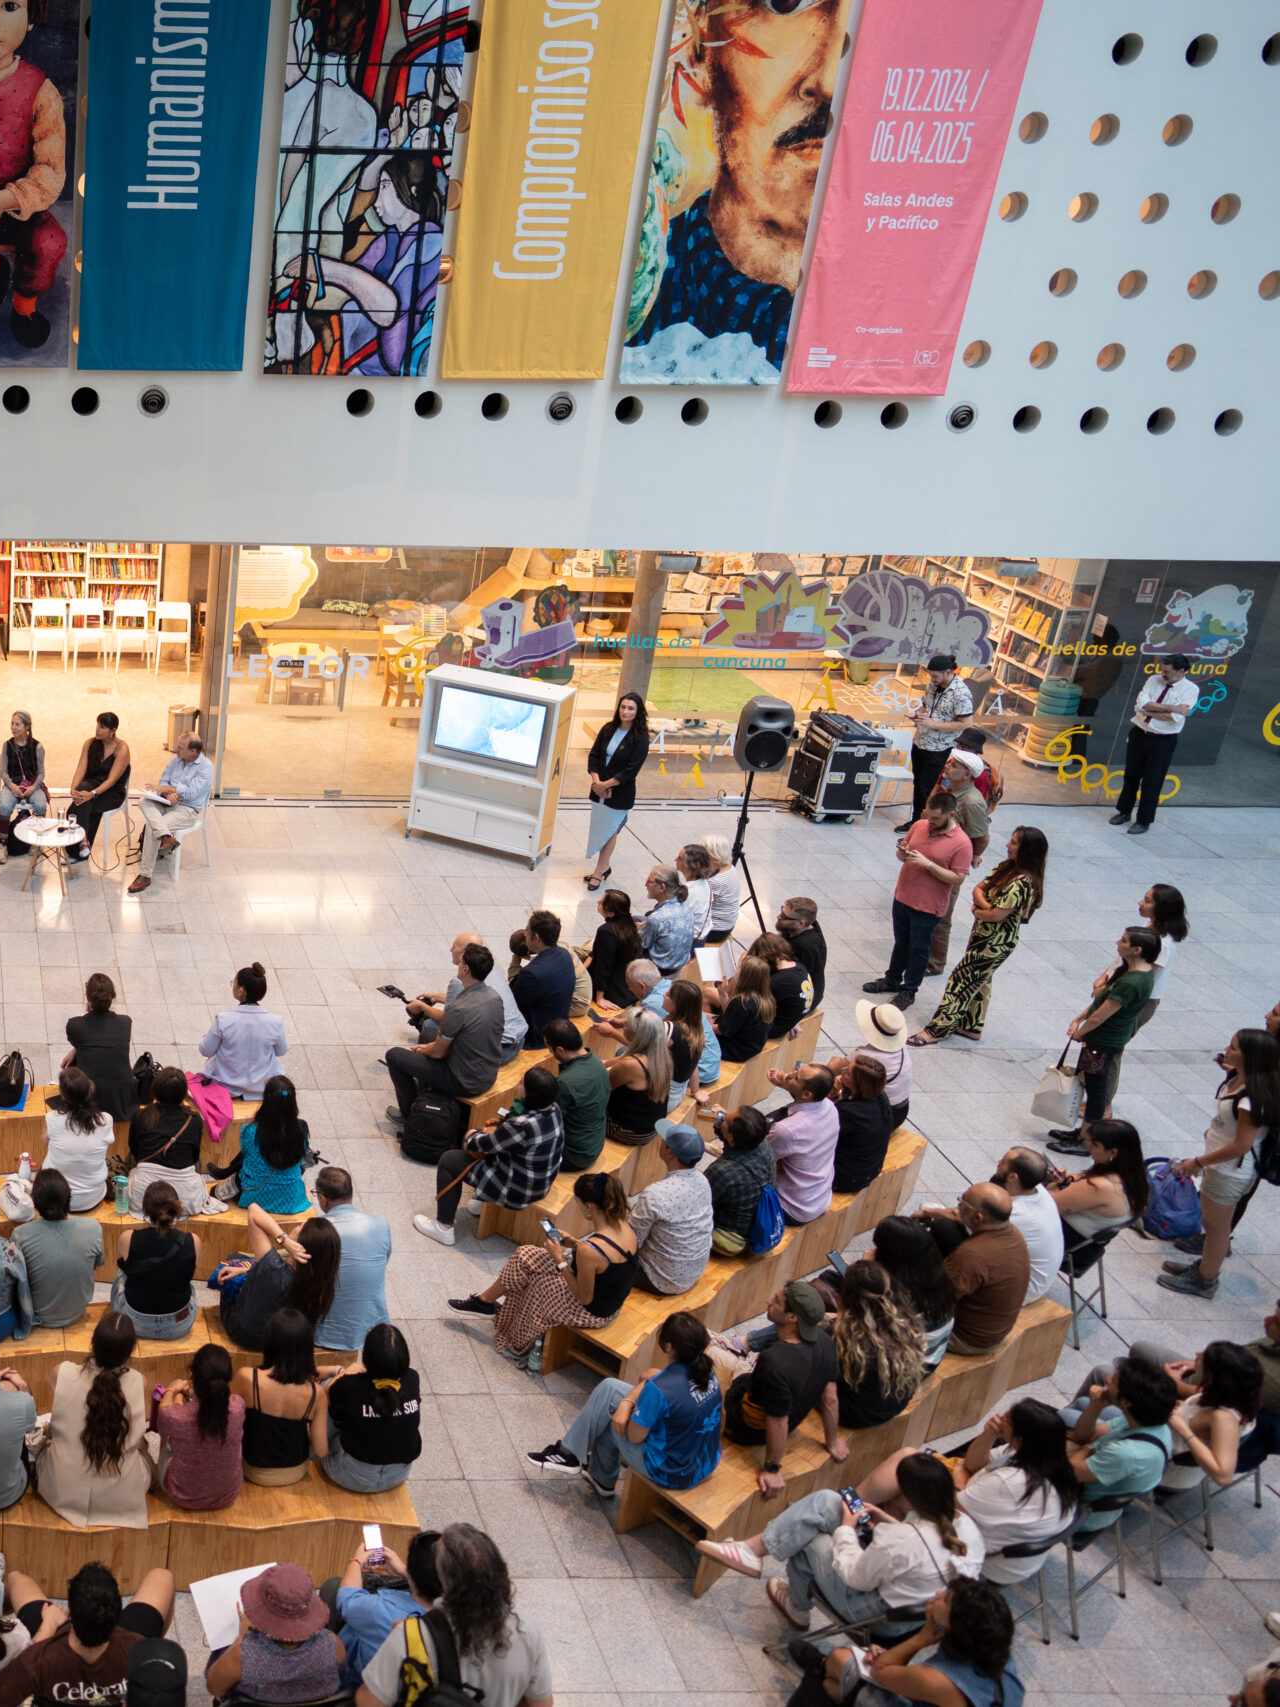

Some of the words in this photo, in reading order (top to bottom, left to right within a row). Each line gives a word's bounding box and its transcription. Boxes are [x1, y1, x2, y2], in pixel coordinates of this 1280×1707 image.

[881, 68, 971, 112] 19.12.2024
[870, 120, 975, 164] 06.04.2025
[493, 40, 595, 280] Compromiso
[863, 192, 902, 207] Salas
[905, 193, 954, 207] Andes
[865, 218, 876, 232] y
[878, 215, 939, 230] Pacífico
[593, 633, 663, 648] huellas
[669, 635, 692, 649] de
[1037, 641, 1108, 655] huellas
[1112, 641, 1136, 656] de
[227, 654, 370, 679] LECTOR
[704, 656, 786, 669] cuncuna
[1144, 663, 1228, 675] cuuna
